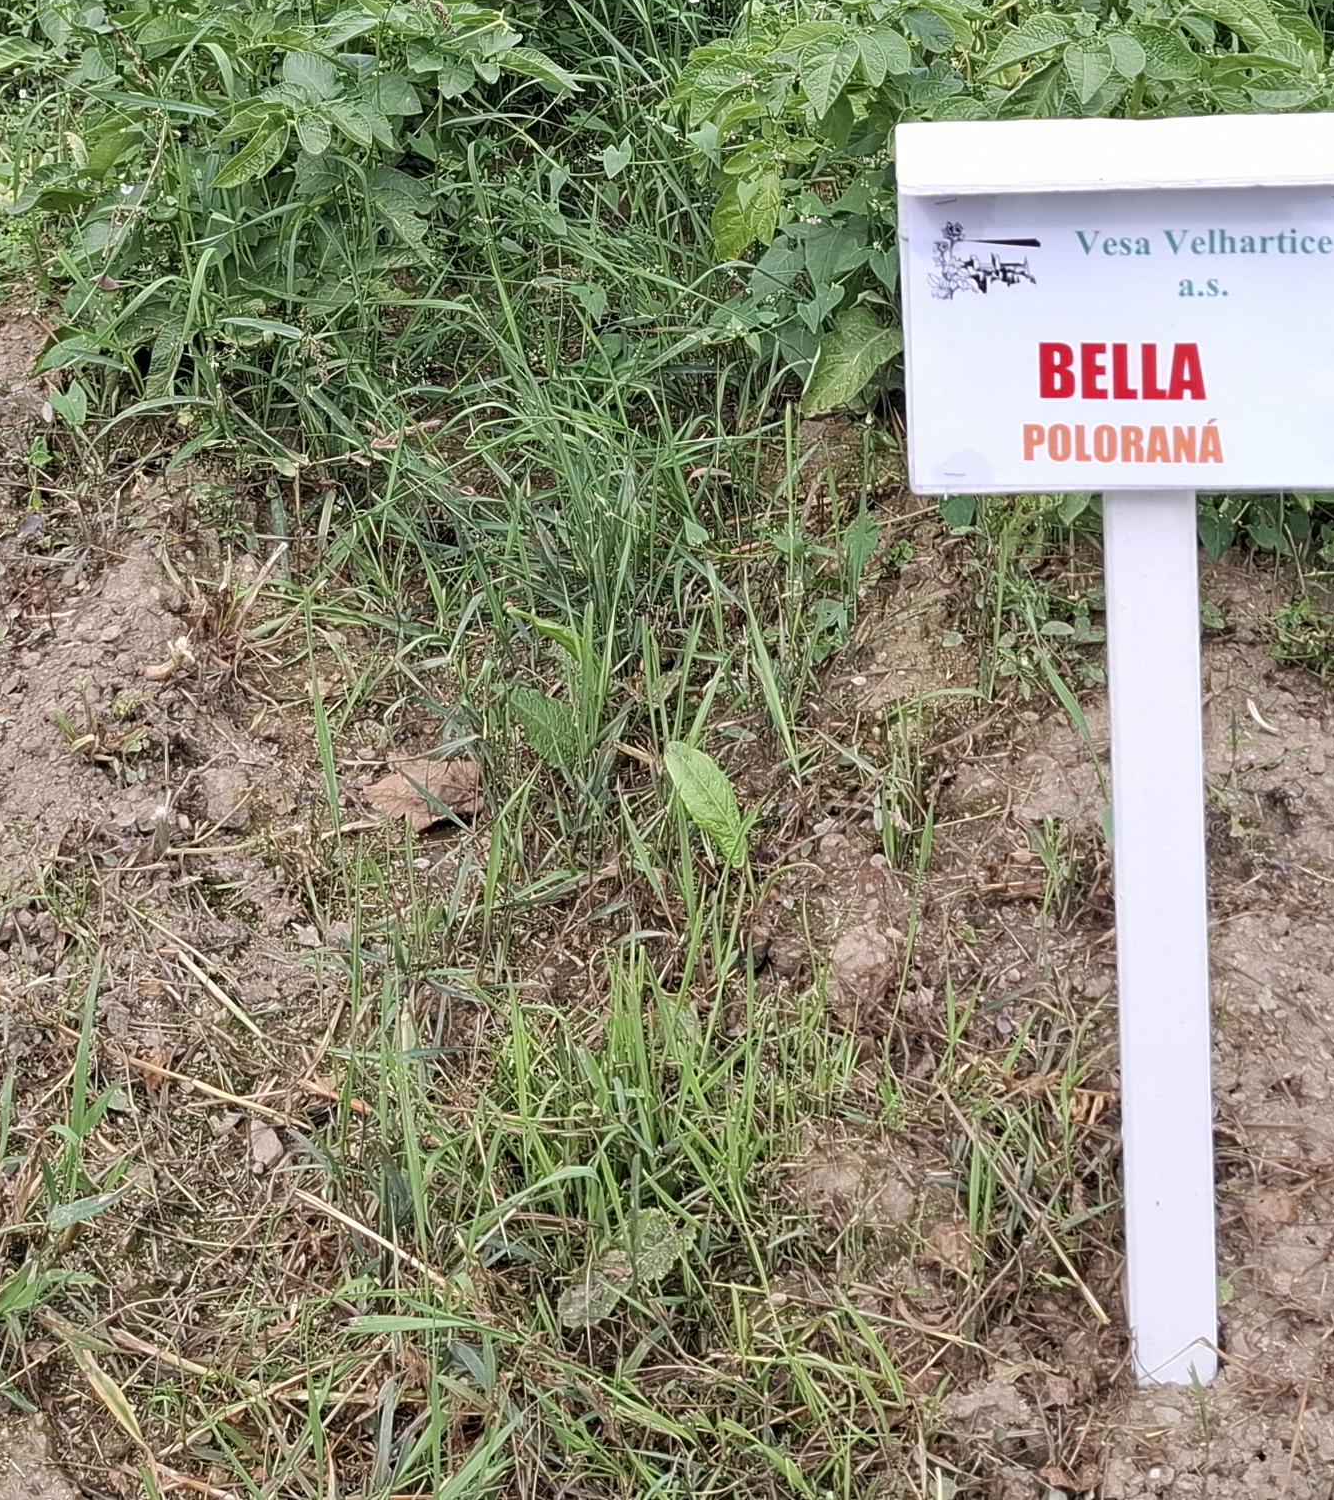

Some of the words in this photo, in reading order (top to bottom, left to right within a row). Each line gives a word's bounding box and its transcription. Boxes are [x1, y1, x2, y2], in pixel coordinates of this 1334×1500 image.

[1074, 229, 1152, 257] Vesa
[1162, 227, 1334, 256] Velhartice
[1177, 277, 1230, 298] a.s.
[1037, 341, 1208, 401] BELLA
[1022, 417, 1225, 465] POLORANÁ
